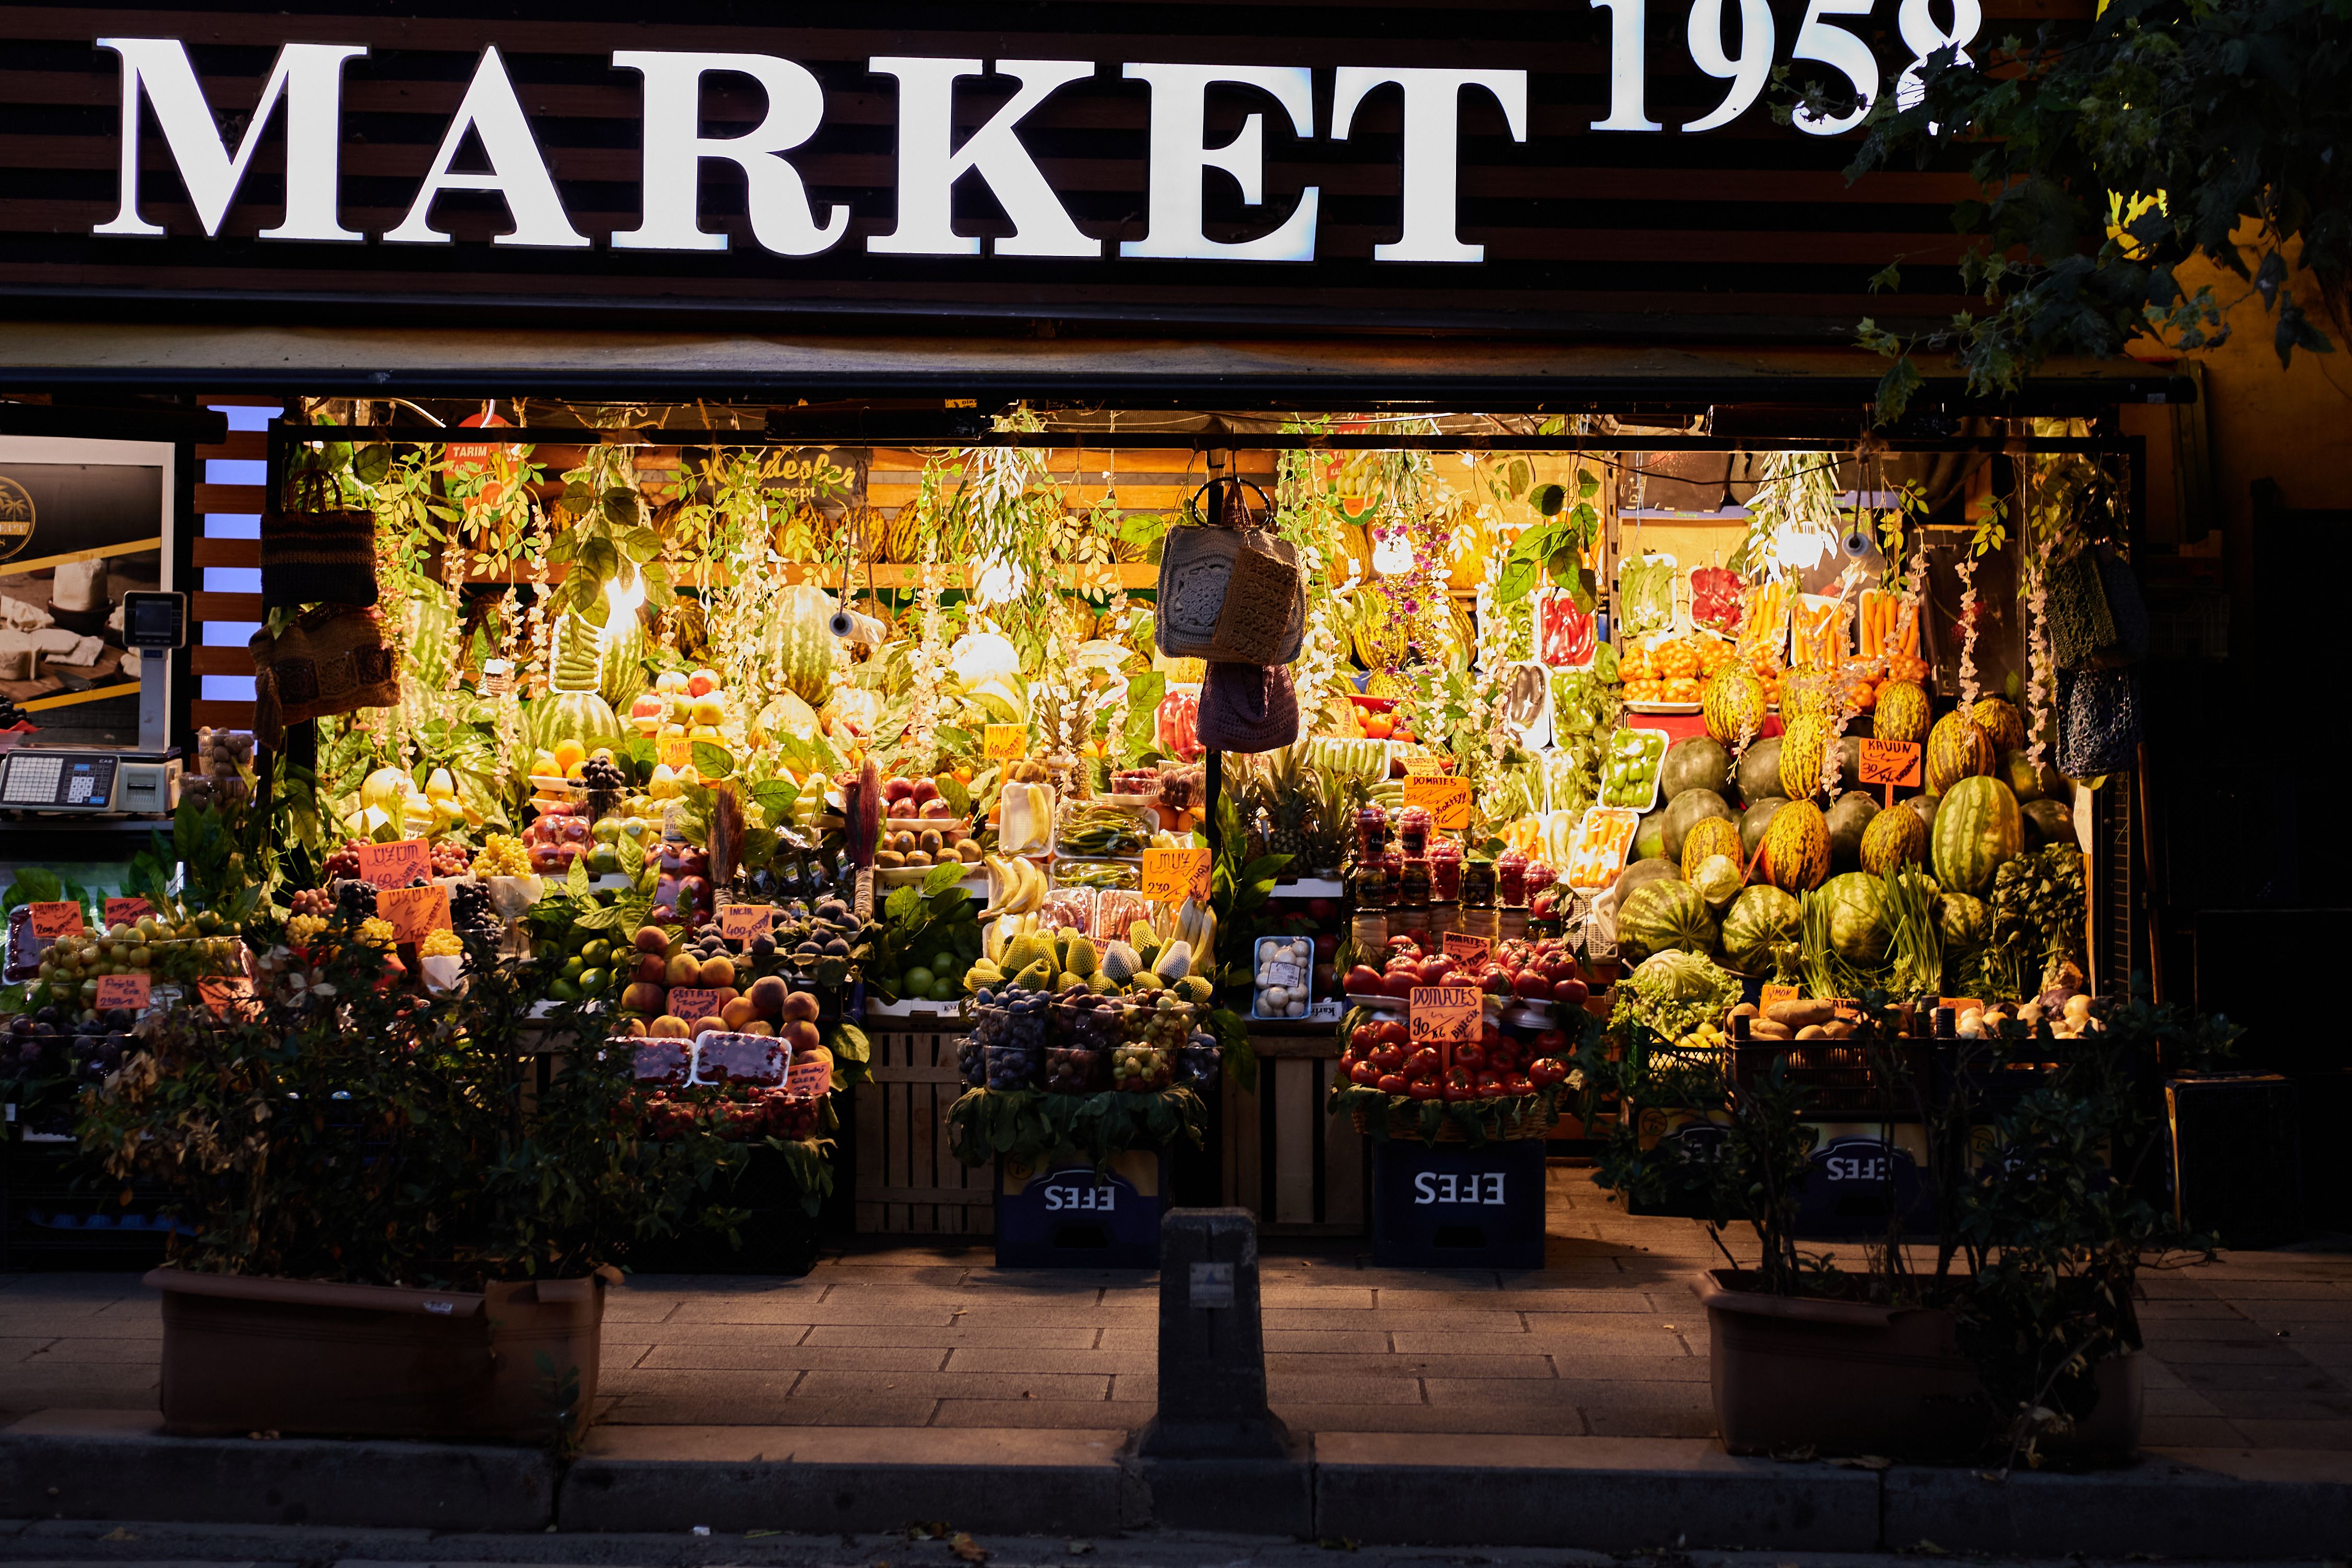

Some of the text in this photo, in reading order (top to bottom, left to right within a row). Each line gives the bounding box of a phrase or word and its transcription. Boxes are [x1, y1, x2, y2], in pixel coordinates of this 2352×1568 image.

[93, 37, 1528, 262] MARKET
[453, 446, 487, 458] TARIM
[1868, 740, 1912, 754] KAVUN
[1862, 763, 1878, 774] 30
[1413, 777, 1457, 786] DOMATES
[1147, 882, 1170, 894] 230
[1446, 933, 1487, 947] DOMATES
[1413, 988, 1477, 1007] DOMATES
[1414, 1172, 1506, 1204] EFES
[1045, 1186, 1114, 1210] EFES
